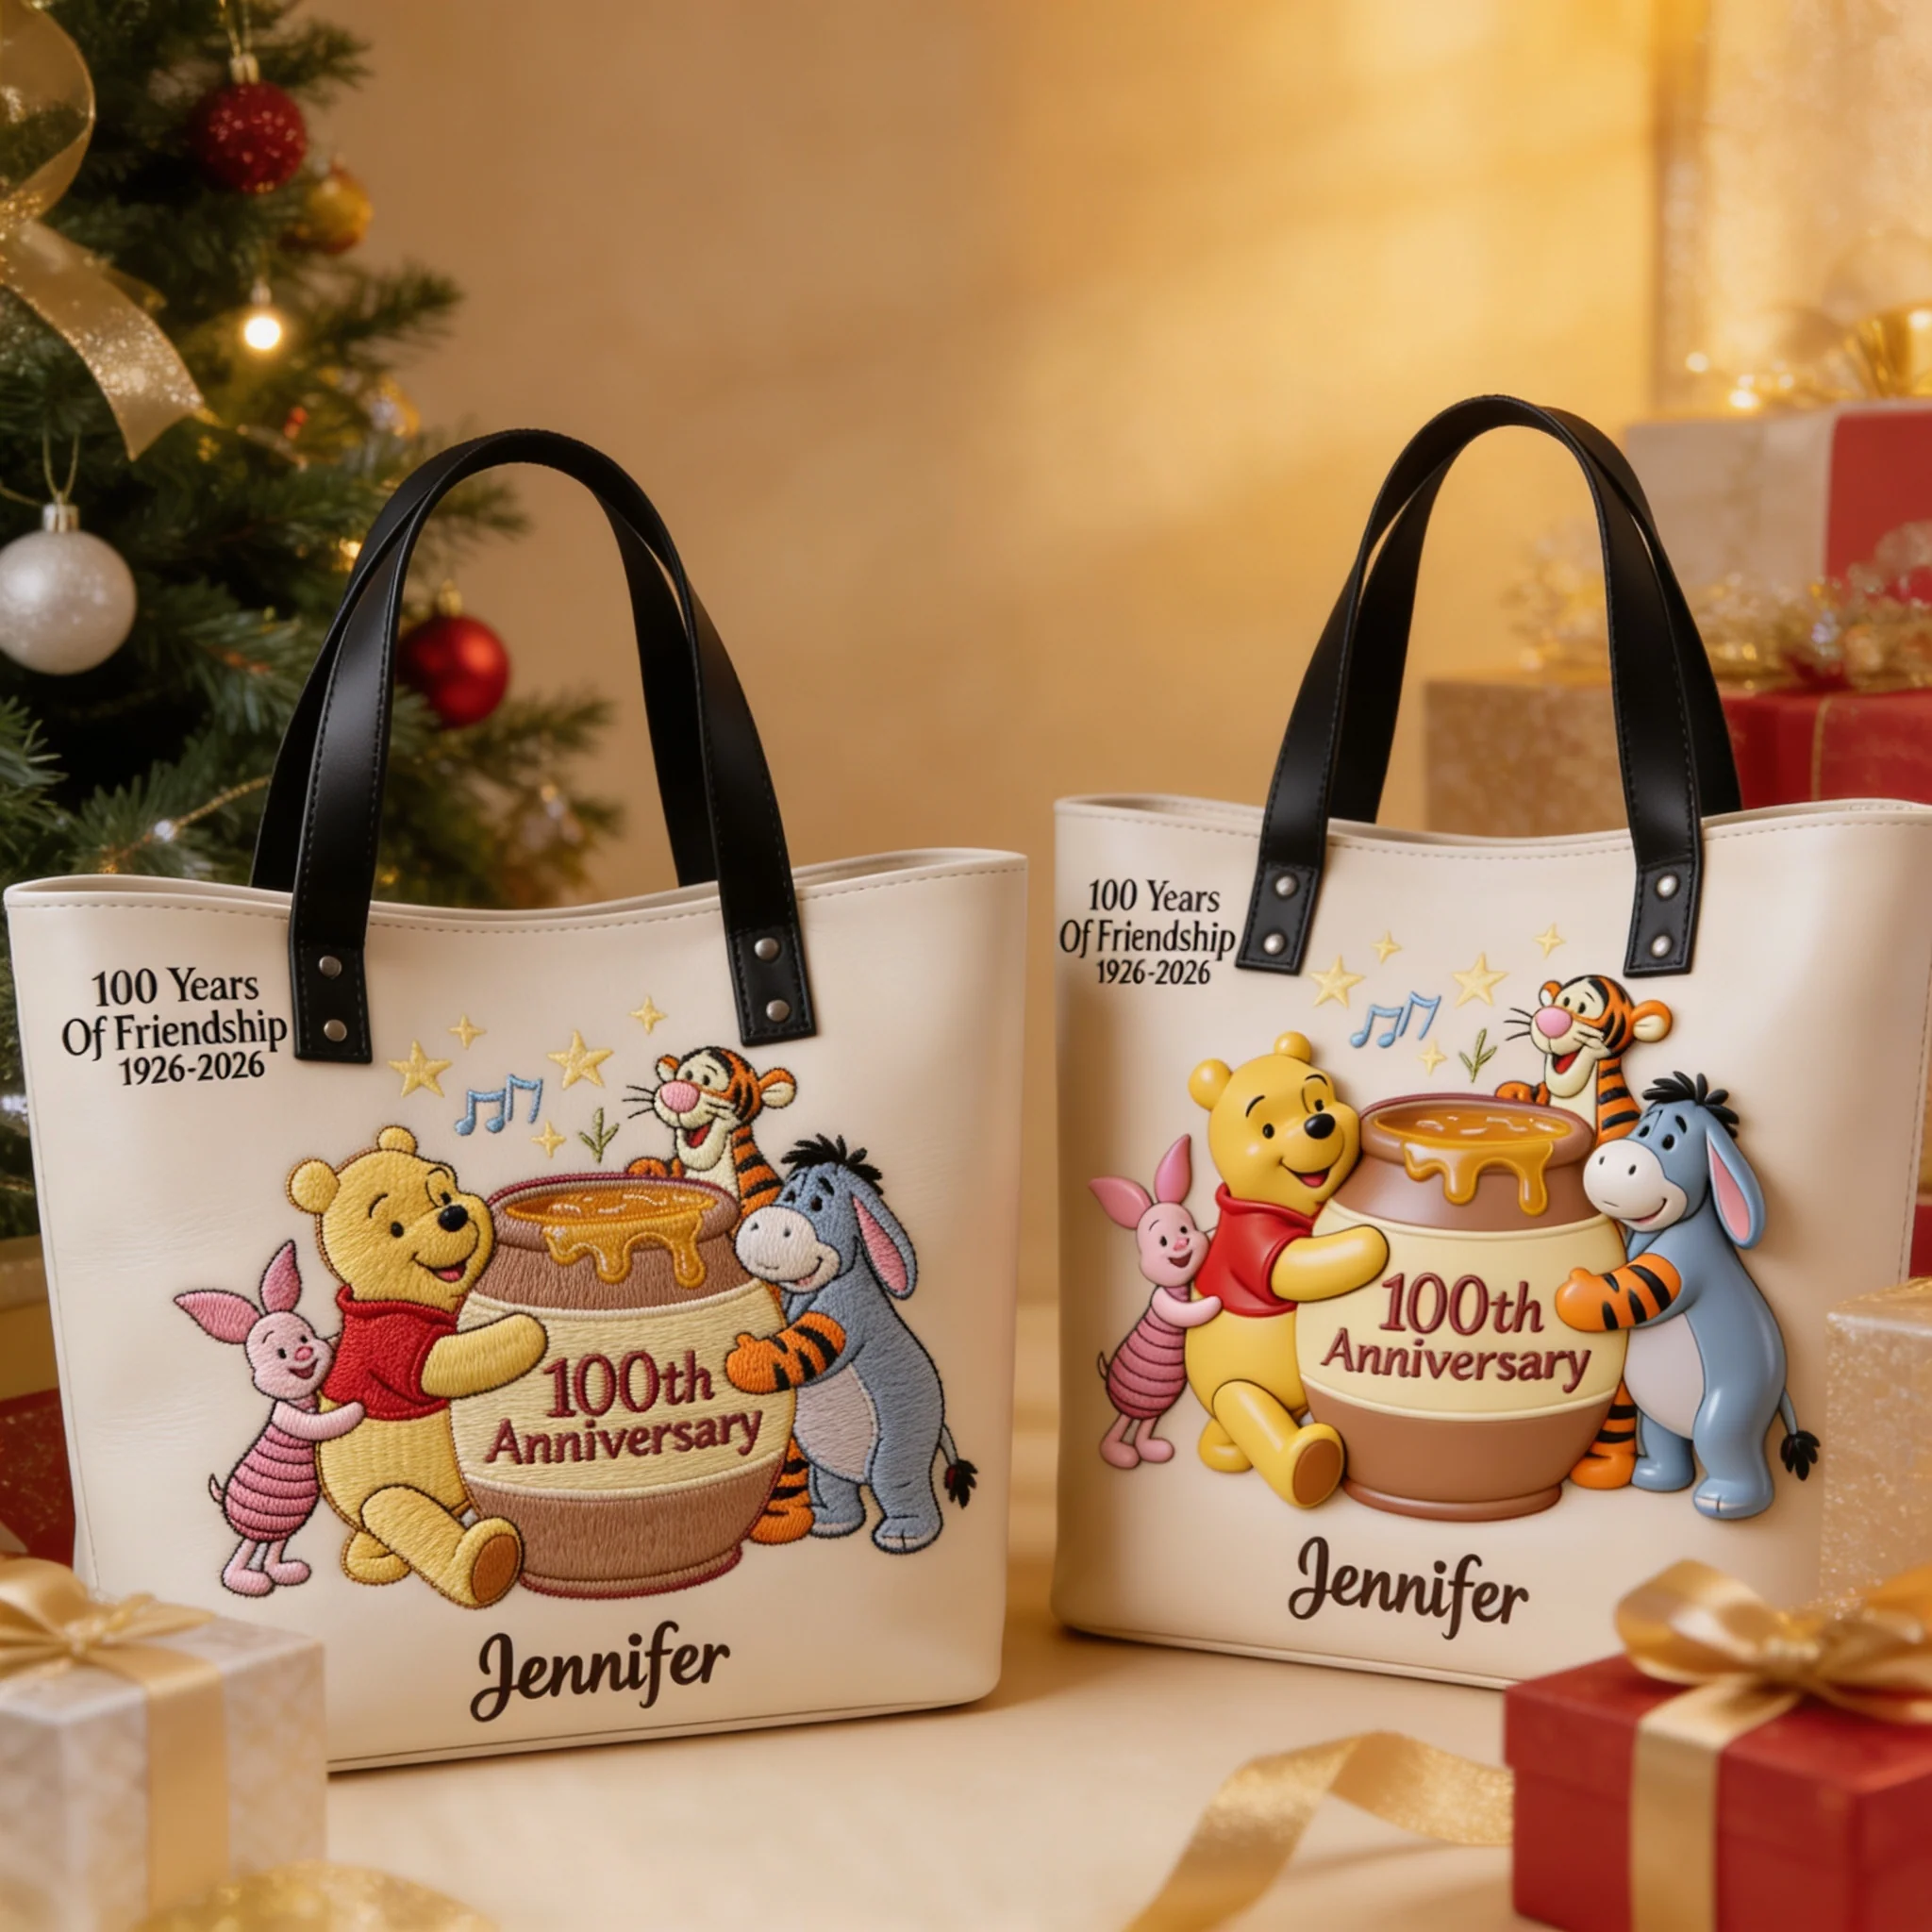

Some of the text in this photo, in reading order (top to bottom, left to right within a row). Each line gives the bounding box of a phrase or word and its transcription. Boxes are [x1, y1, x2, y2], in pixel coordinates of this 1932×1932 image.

[1089, 878, 1221, 913] 100 Years
[1058, 919, 1236, 962] Of Friendship
[92, 966, 259, 1008] 100 Years
[1095, 958, 1211, 985] 1926-2026
[61, 1008, 288, 1062] Of Friendship
[119, 1050, 265, 1086] 1926-2026
[1379, 1273, 1544, 1337] 100th
[542, 1350, 715, 1418] 100th
[1320, 1326, 1591, 1394] Anniversary
[484, 1409, 763, 1465] Anniversary
[1288, 1536, 1530, 1641] Jennifer
[469, 1620, 731, 1724] Jennifer
